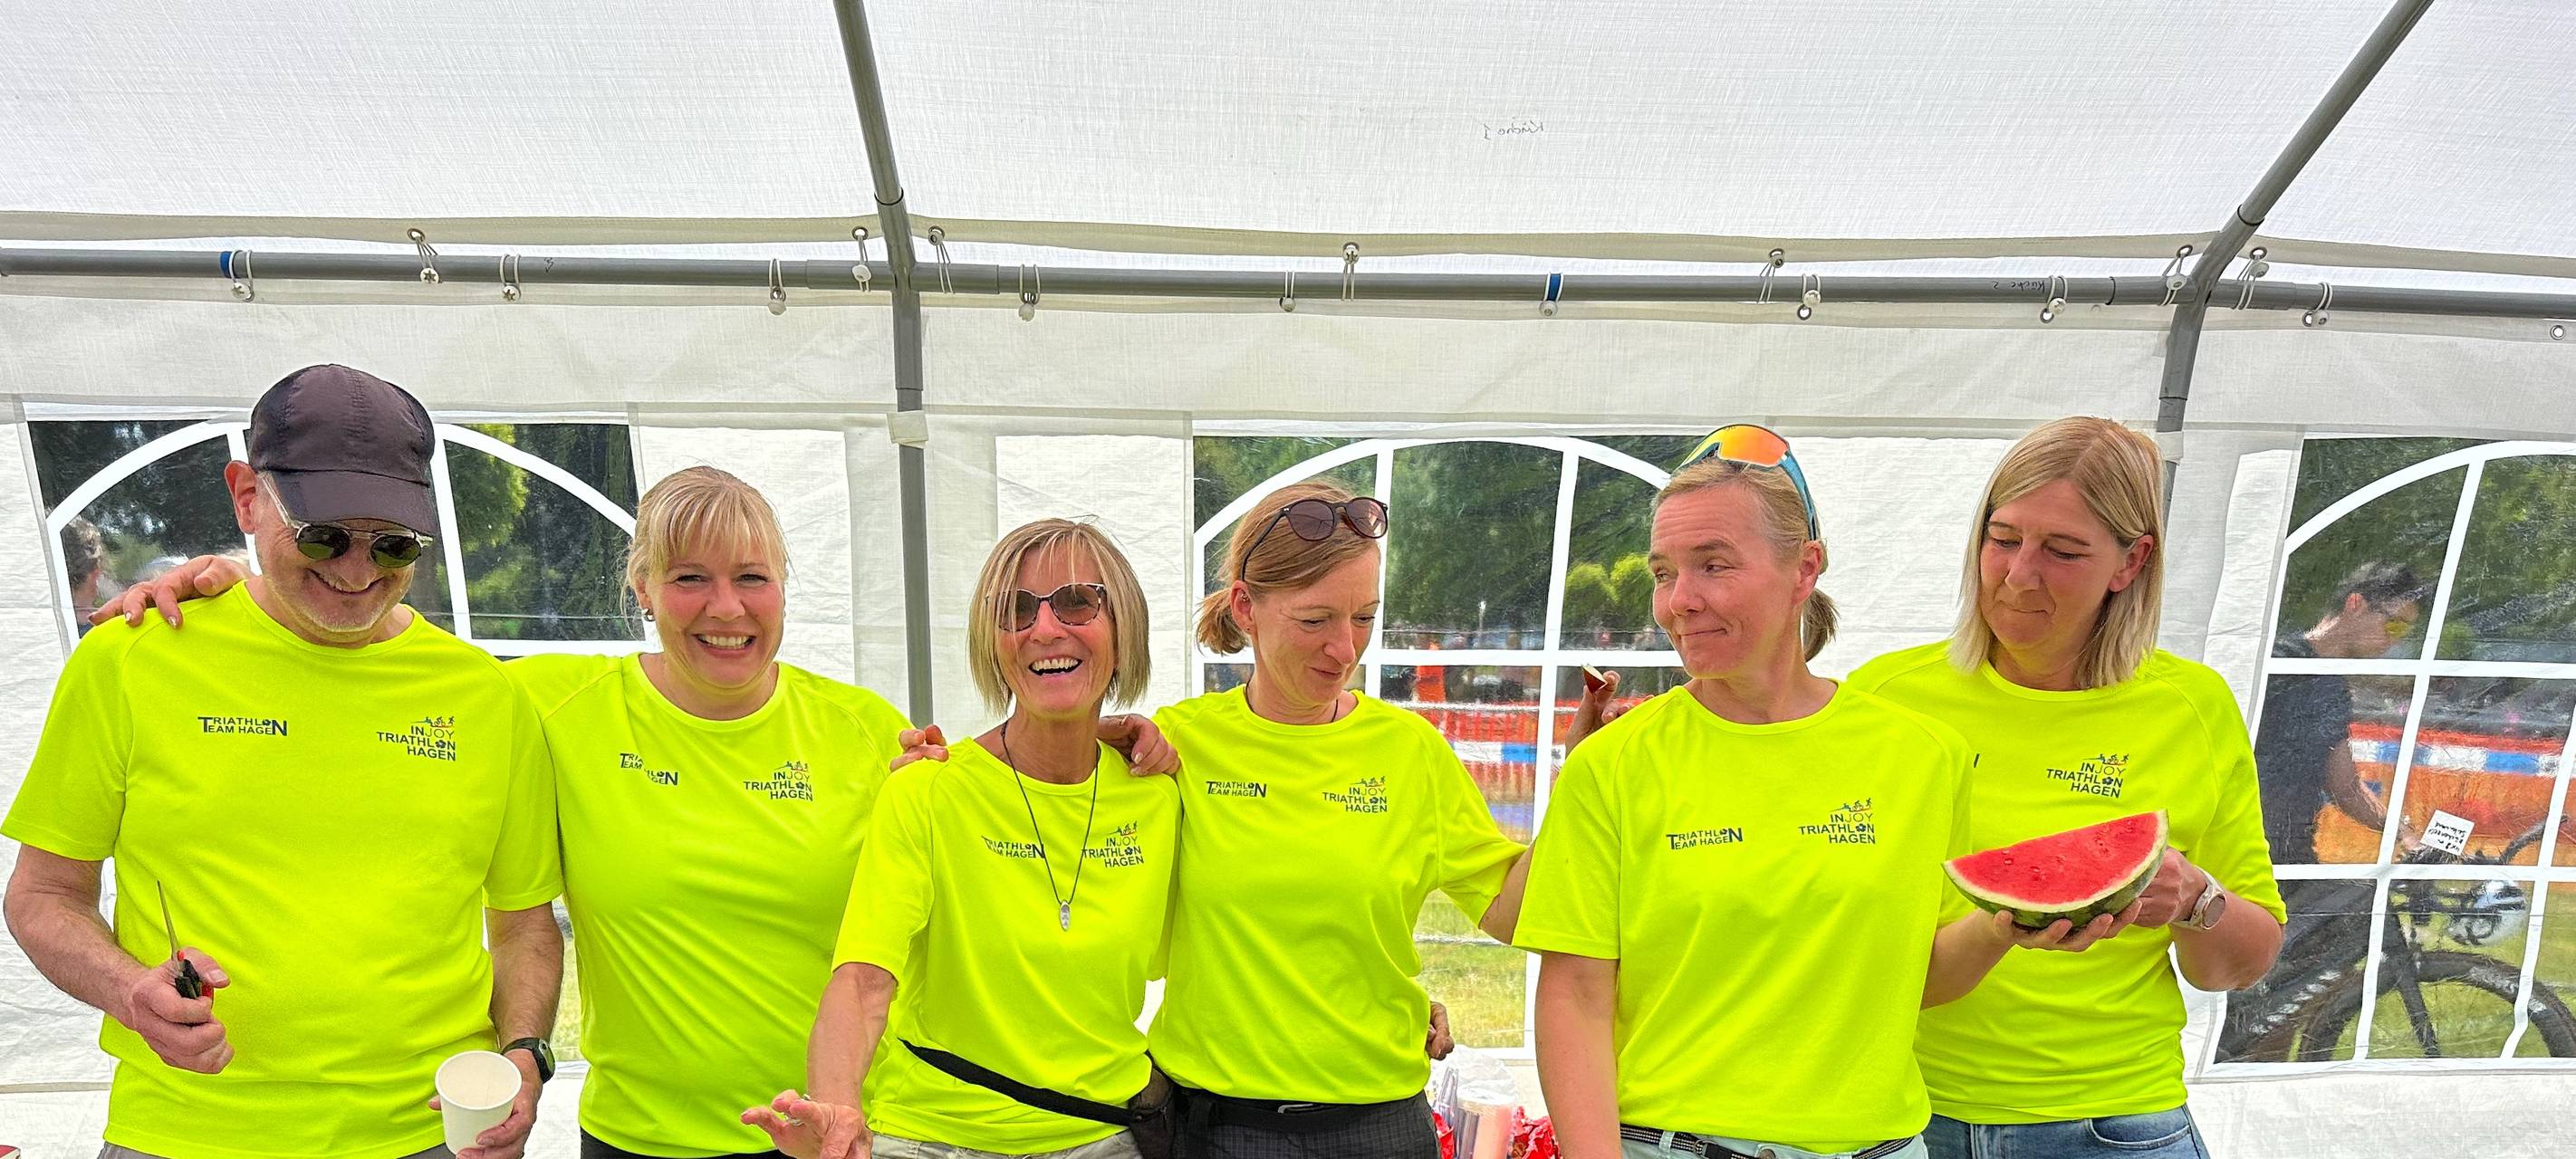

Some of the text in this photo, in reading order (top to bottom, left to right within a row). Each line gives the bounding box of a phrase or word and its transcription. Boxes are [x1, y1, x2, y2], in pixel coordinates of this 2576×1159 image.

[410, 725, 455, 739] INJOY
[407, 746, 456, 761] HAGEN
[2081, 762, 2126, 777] INJOY
[774, 771, 811, 782] INJOY
[770, 790, 812, 802] HAGEN
[1350, 787, 1386, 796] INJOY
[2070, 782, 2120, 799] HAGEN
[1345, 804, 1388, 813] HAGEN
[1830, 813, 1873, 822] INJOY
[1106, 836, 1138, 847] INJOY
[1829, 833, 1876, 844] HAGEN
[1104, 855, 1144, 867] HAGEN
